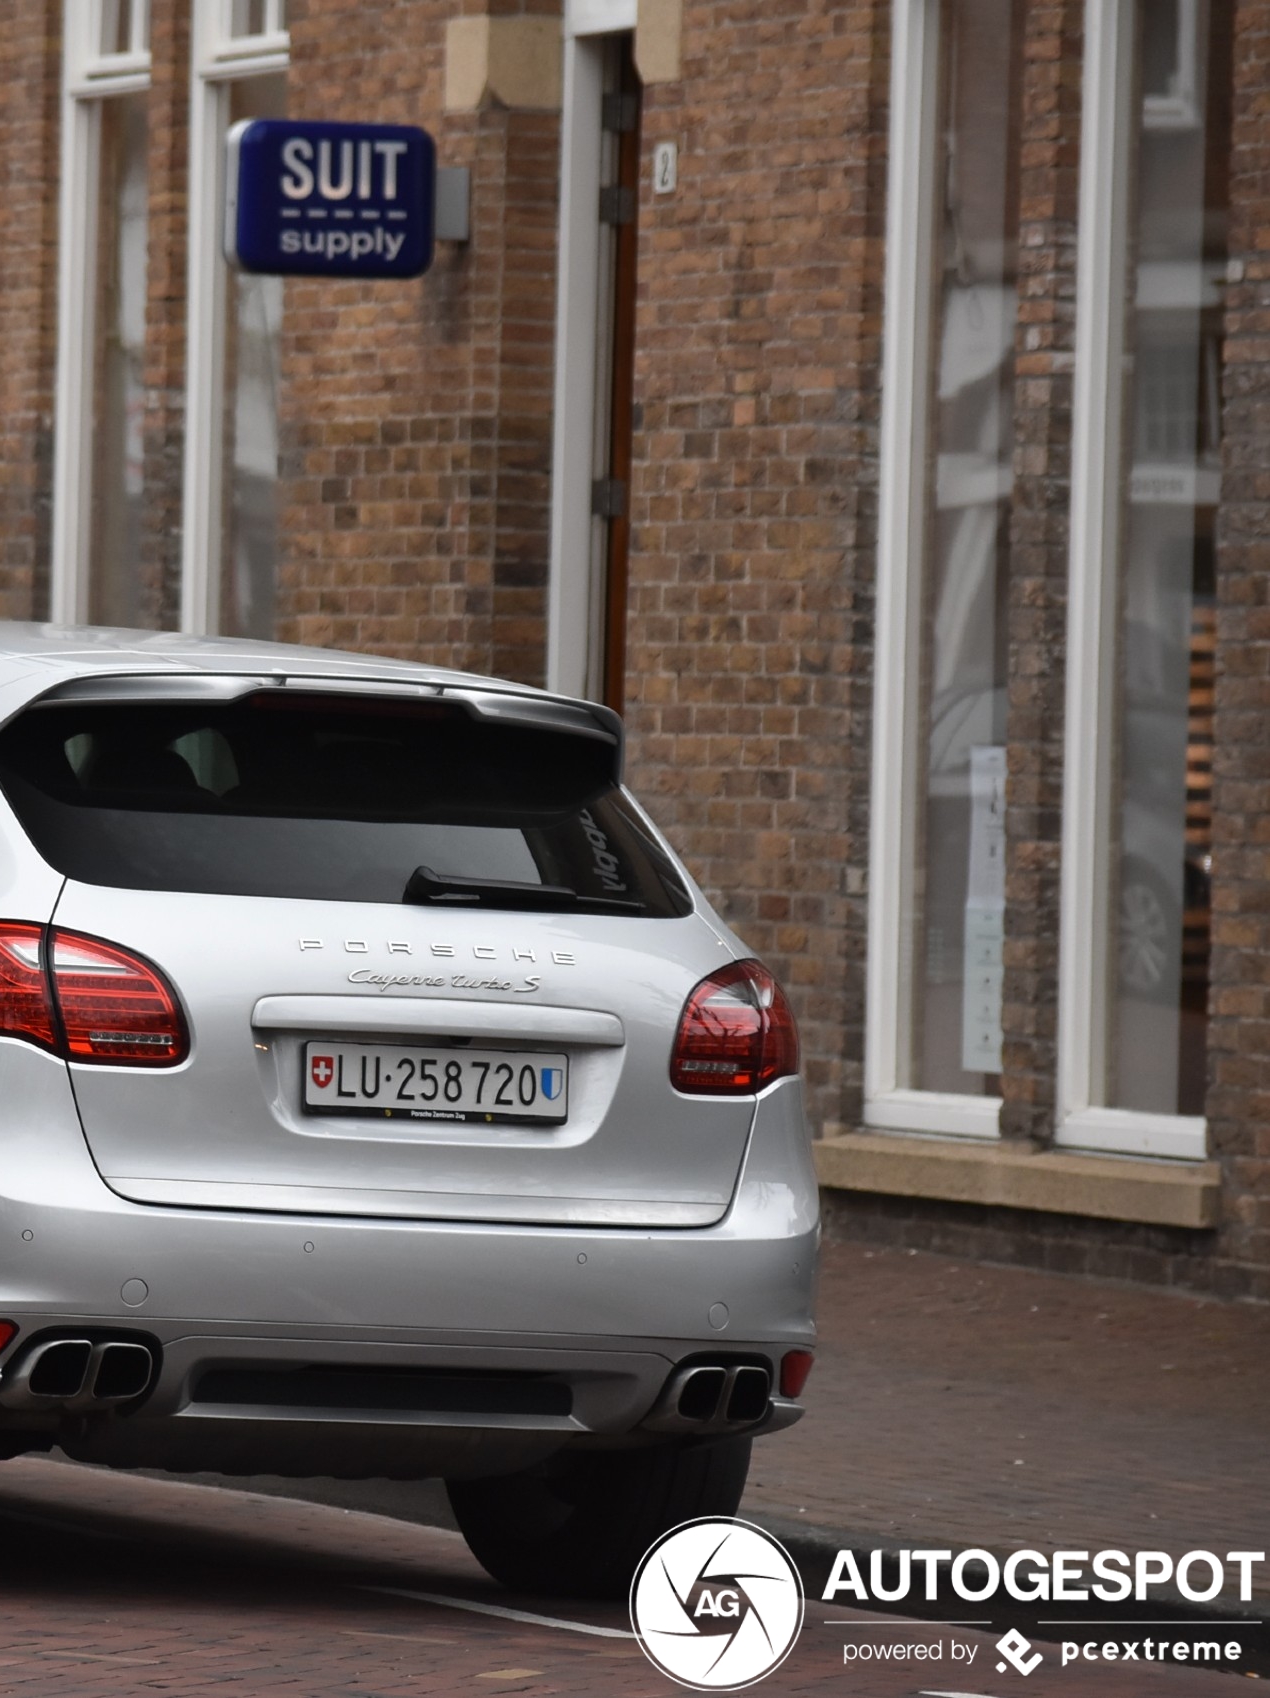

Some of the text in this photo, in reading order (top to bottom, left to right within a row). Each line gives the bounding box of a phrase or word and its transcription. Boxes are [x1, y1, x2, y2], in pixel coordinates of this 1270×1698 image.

[282, 138, 408, 200] SUIT
[661, 150, 670, 187] 2
[281, 227, 406, 261] supply
[299, 938, 576, 965] PORSCHE
[348, 968, 542, 993] Cayenne Turbo S
[411, 1110, 466, 1121] Porsche Zentrum Zug
